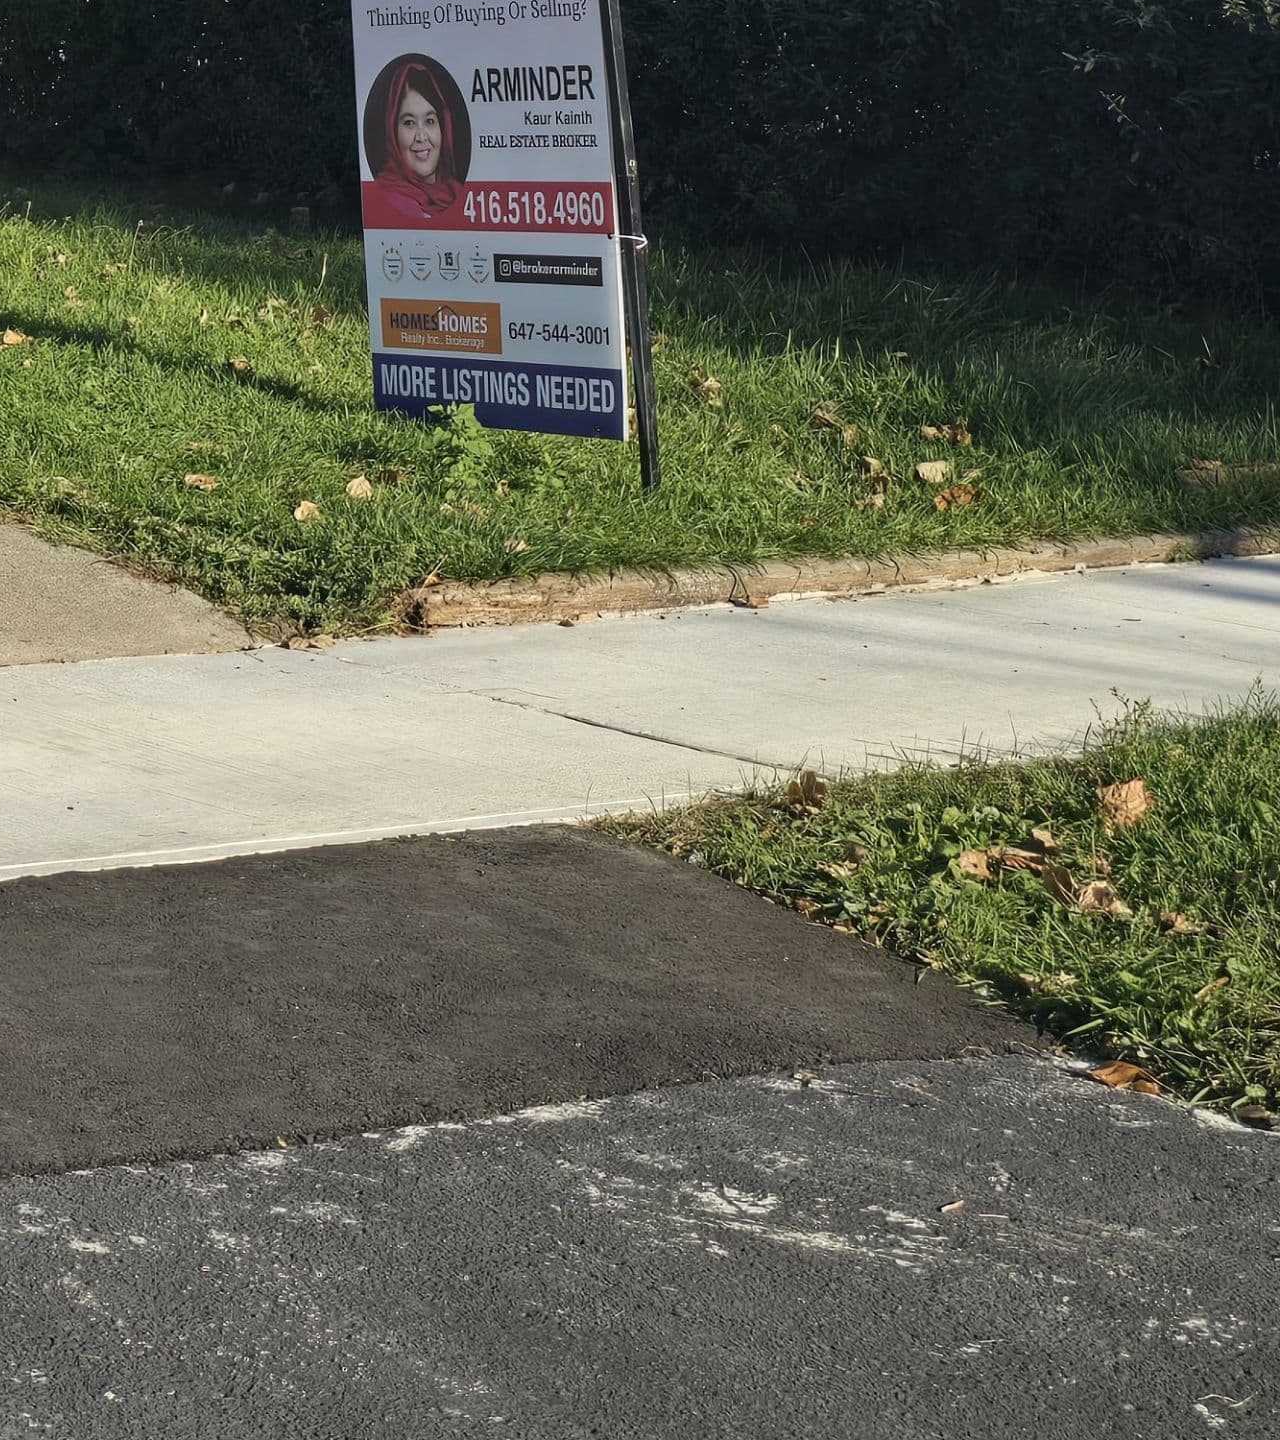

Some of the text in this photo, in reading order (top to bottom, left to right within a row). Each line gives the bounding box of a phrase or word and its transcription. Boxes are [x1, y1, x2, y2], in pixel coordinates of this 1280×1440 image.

[366, 6, 431, 29] Thinking
[434, 3, 452, 23] Of
[454, 2, 505, 26] Buying
[509, 1, 527, 19] Or
[471, 64, 595, 103] ARMINDER
[524, 110, 593, 125] Kaur Kainth
[479, 134, 598, 148] REAL ESTATE BROKER
[463, 190, 605, 226] 416.518.4960
[508, 321, 611, 346] 647-544-3001
[380, 363, 616, 414] MORE LISTINGS NEEDED
